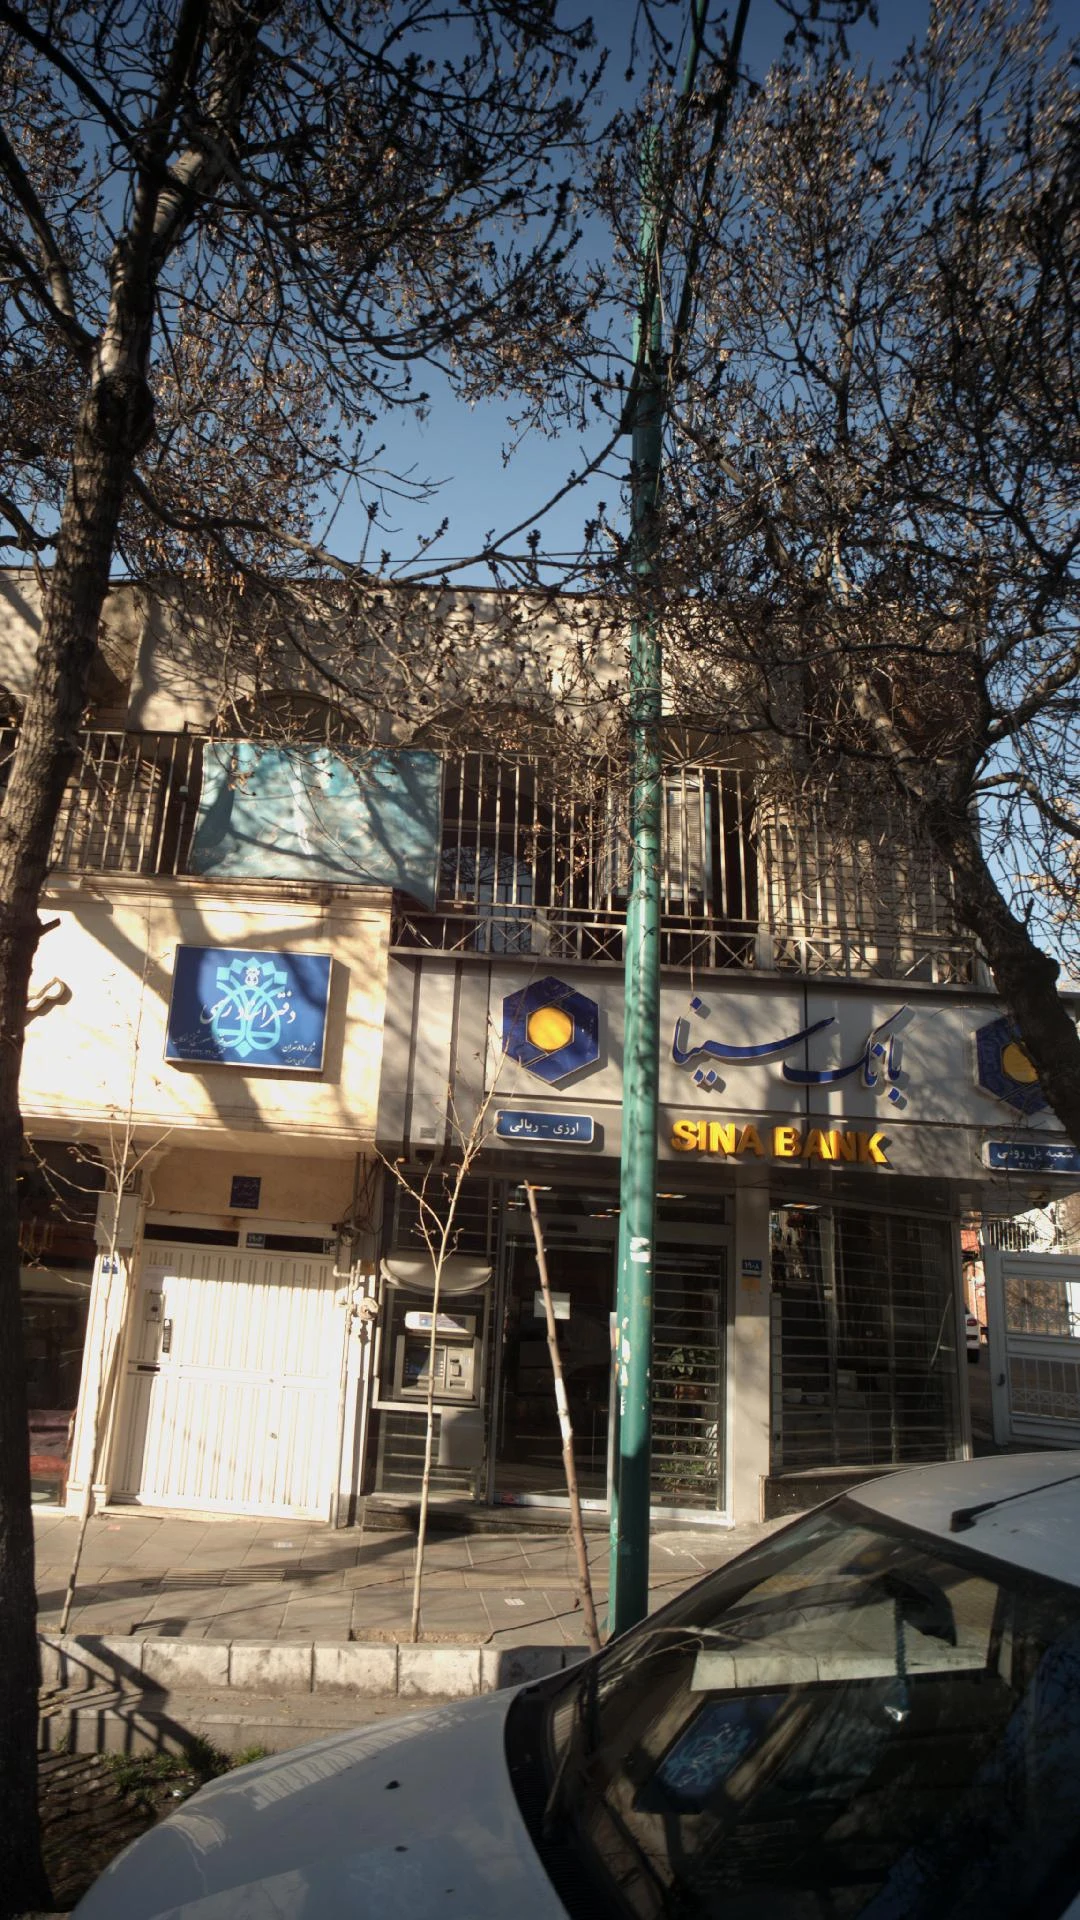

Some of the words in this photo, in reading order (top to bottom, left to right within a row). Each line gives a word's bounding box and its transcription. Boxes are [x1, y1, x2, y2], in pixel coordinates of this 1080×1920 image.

[200, 995, 234, 1025] رسمی
[260, 990, 296, 1028] دفتر
[672, 997, 836, 1087] سینا
[781, 1002, 908, 1103] بانک
[509, 1118, 539, 1133] ریالی
[552, 1121, 580, 1136] ارزی
[671, 1119, 765, 1160] SINA
[773, 1126, 890, 1165] BANK
[1028, 1147, 1043, 1161] پل
[1046, 1148, 1074, 1161] شعبه
